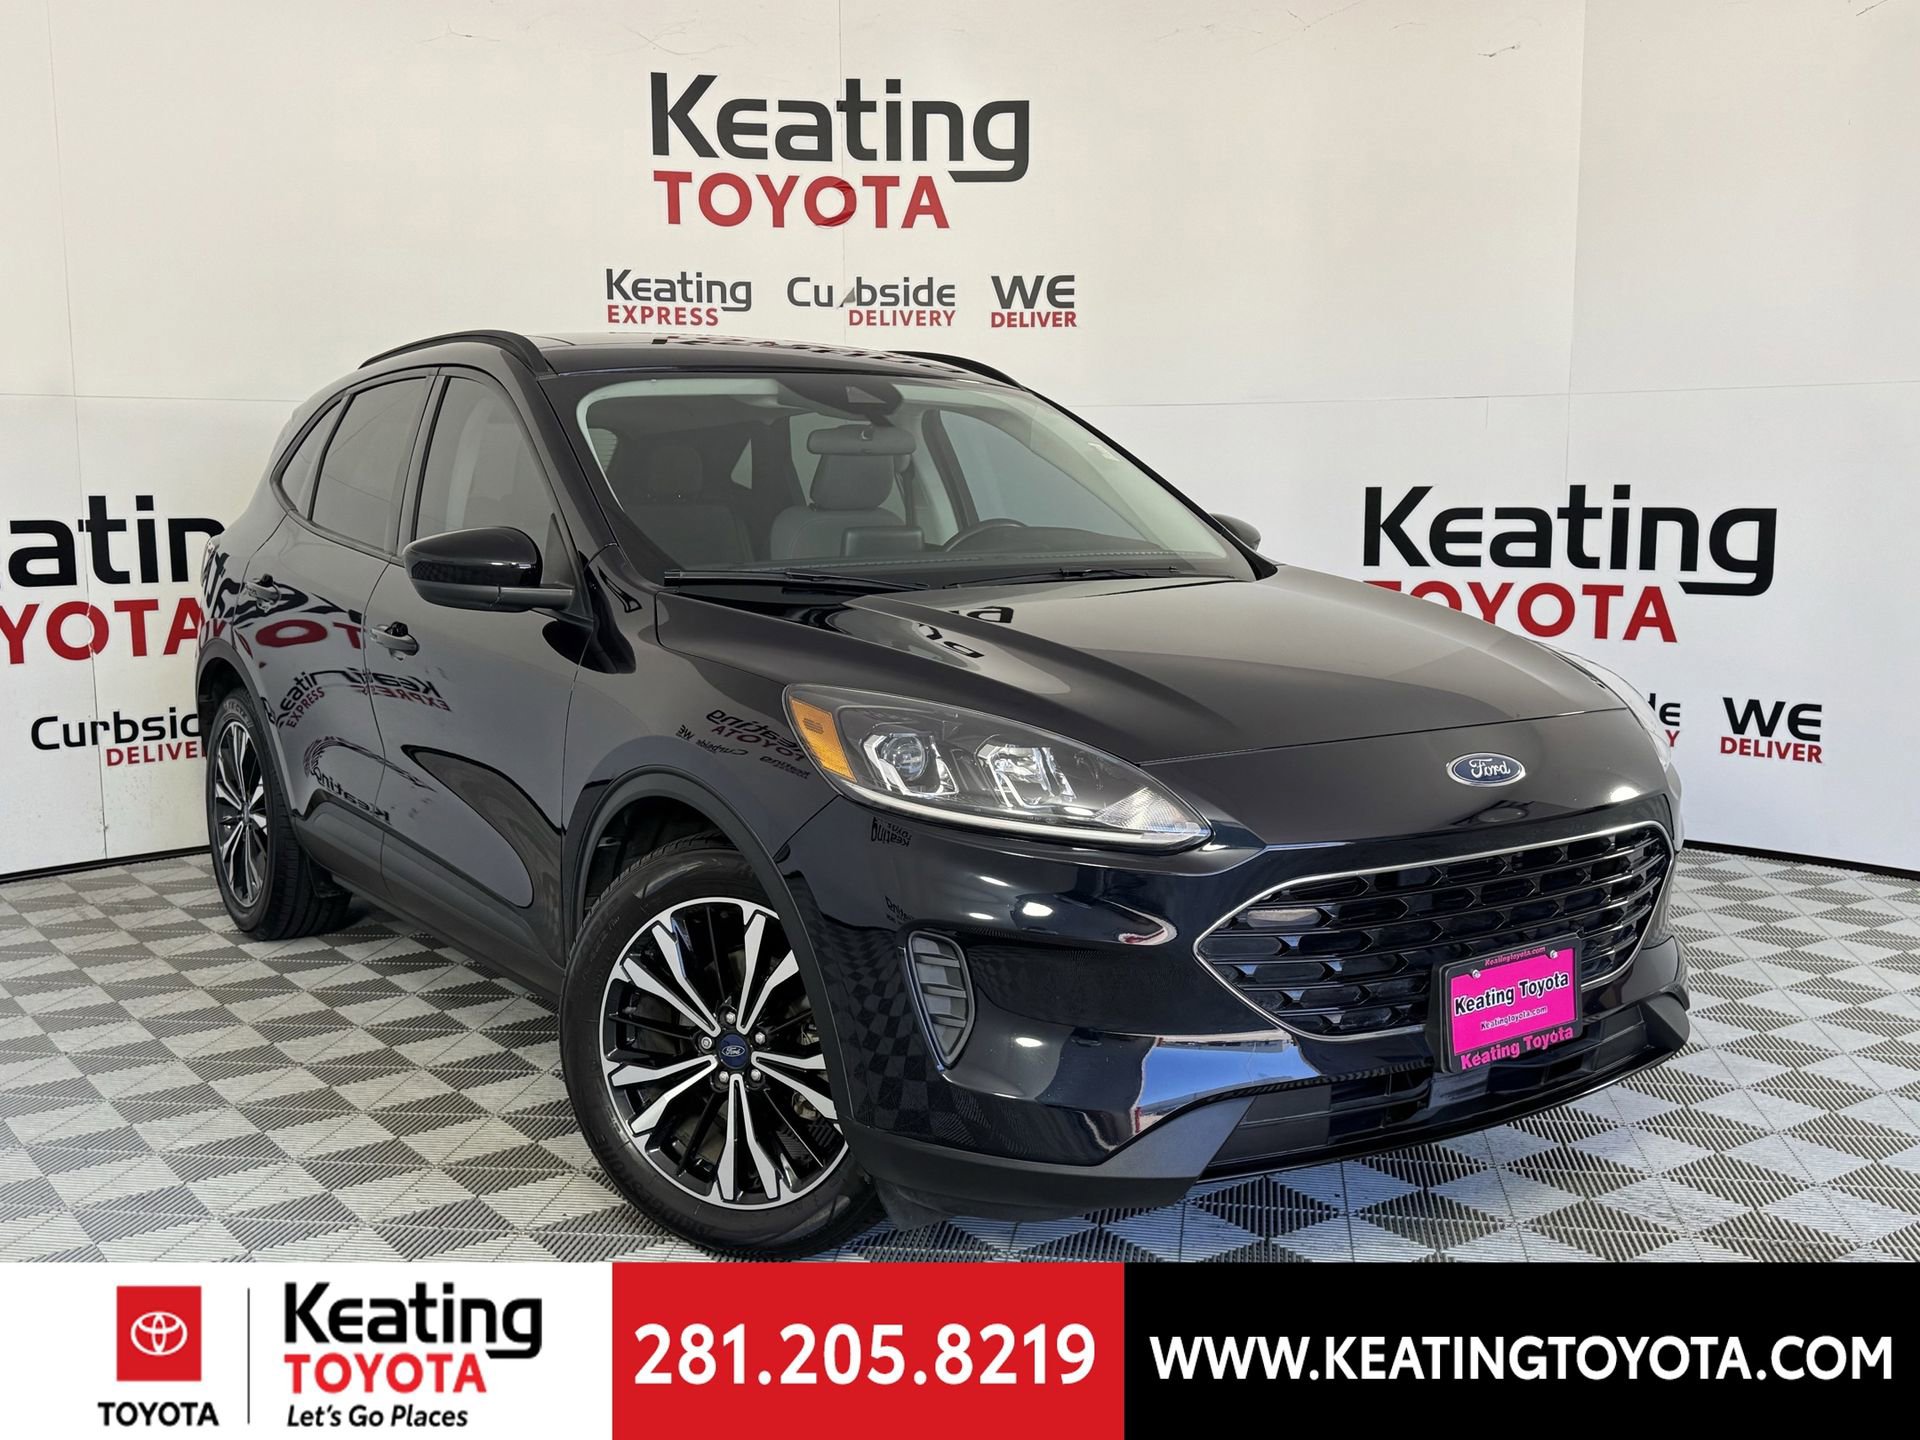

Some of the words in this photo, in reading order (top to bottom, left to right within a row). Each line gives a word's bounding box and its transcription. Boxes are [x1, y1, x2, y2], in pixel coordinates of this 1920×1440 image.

[650, 71, 1030, 183] Keating
[653, 170, 950, 229] TOYOTA
[606, 268, 752, 312] Keating
[786, 276, 956, 308] Cubside
[991, 274, 1076, 310] WE
[607, 304, 719, 327] EXPRESS
[848, 309, 956, 328] DELIVERY
[991, 311, 1077, 328] DELIVER
[1363, 484, 1778, 597] Keating
[1363, 580, 1678, 643] YOTA
[1722, 697, 1823, 743] WE
[106, 740, 207, 767] DELIVE
[1720, 736, 1823, 763] DELIVER
[1455, 986, 1515, 1015] Keating
[1519, 972, 1569, 999] Toyota
[1460, 1040, 1521, 1071] Keating
[1523, 1026, 1574, 1051] Toyota
